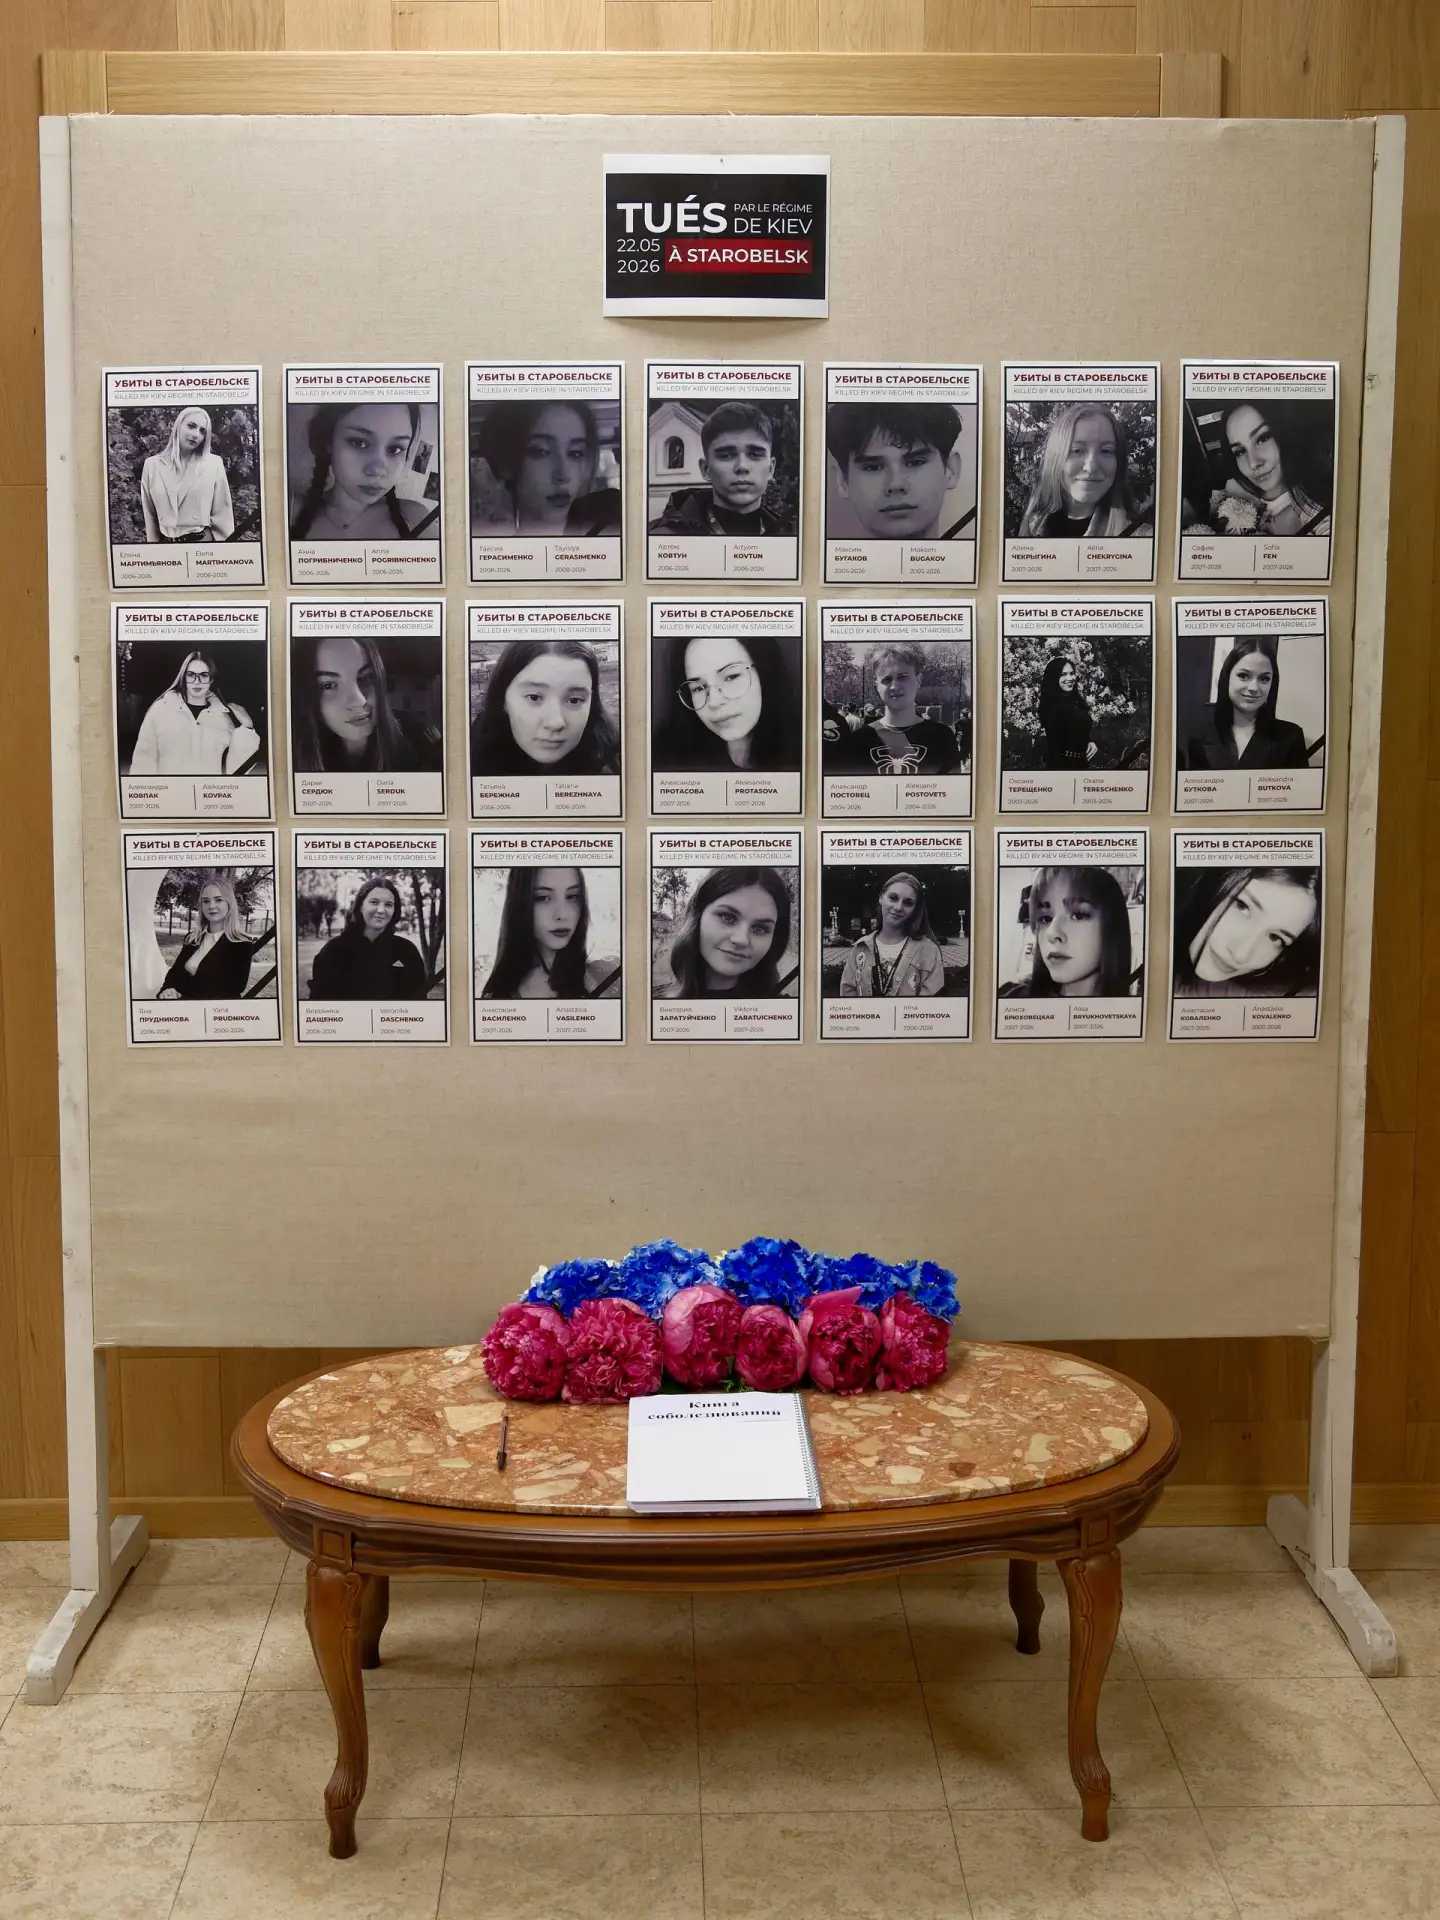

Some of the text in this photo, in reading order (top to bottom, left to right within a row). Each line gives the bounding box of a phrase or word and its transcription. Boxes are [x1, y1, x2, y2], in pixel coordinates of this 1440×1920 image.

[734, 202, 812, 213] PAR LE RÉGIME
[617, 195, 728, 233] TUÉS
[734, 218, 813, 234] DE KIEV
[617, 239, 660, 252] 22.05
[669, 246, 808, 263] À STAROBELSK
[617, 260, 660, 273] 2026
[707, 372, 791, 380] СТАРОБЕЛЬСКЕ
[886, 376, 969, 384] СТАРОБЕЛЬСКЕ
[165, 378, 249, 386] СТАРОБЕЛЬСКЕ
[528, 613, 611, 621] СТАРОБЕЛЬСКЕ
[1185, 609, 1221, 617] УБИТЫ
[1234, 608, 1317, 616] СТАРОБЕЛЬСКЕ
[133, 841, 170, 849] УБИТЫ
[183, 840, 266, 848] СТАРОБЕЛЬСКЕ
[880, 838, 962, 846] СТАРОБЕЛЬСКЕ
[1232, 840, 1313, 848] СТАРОБЕЛЬСКЕ
